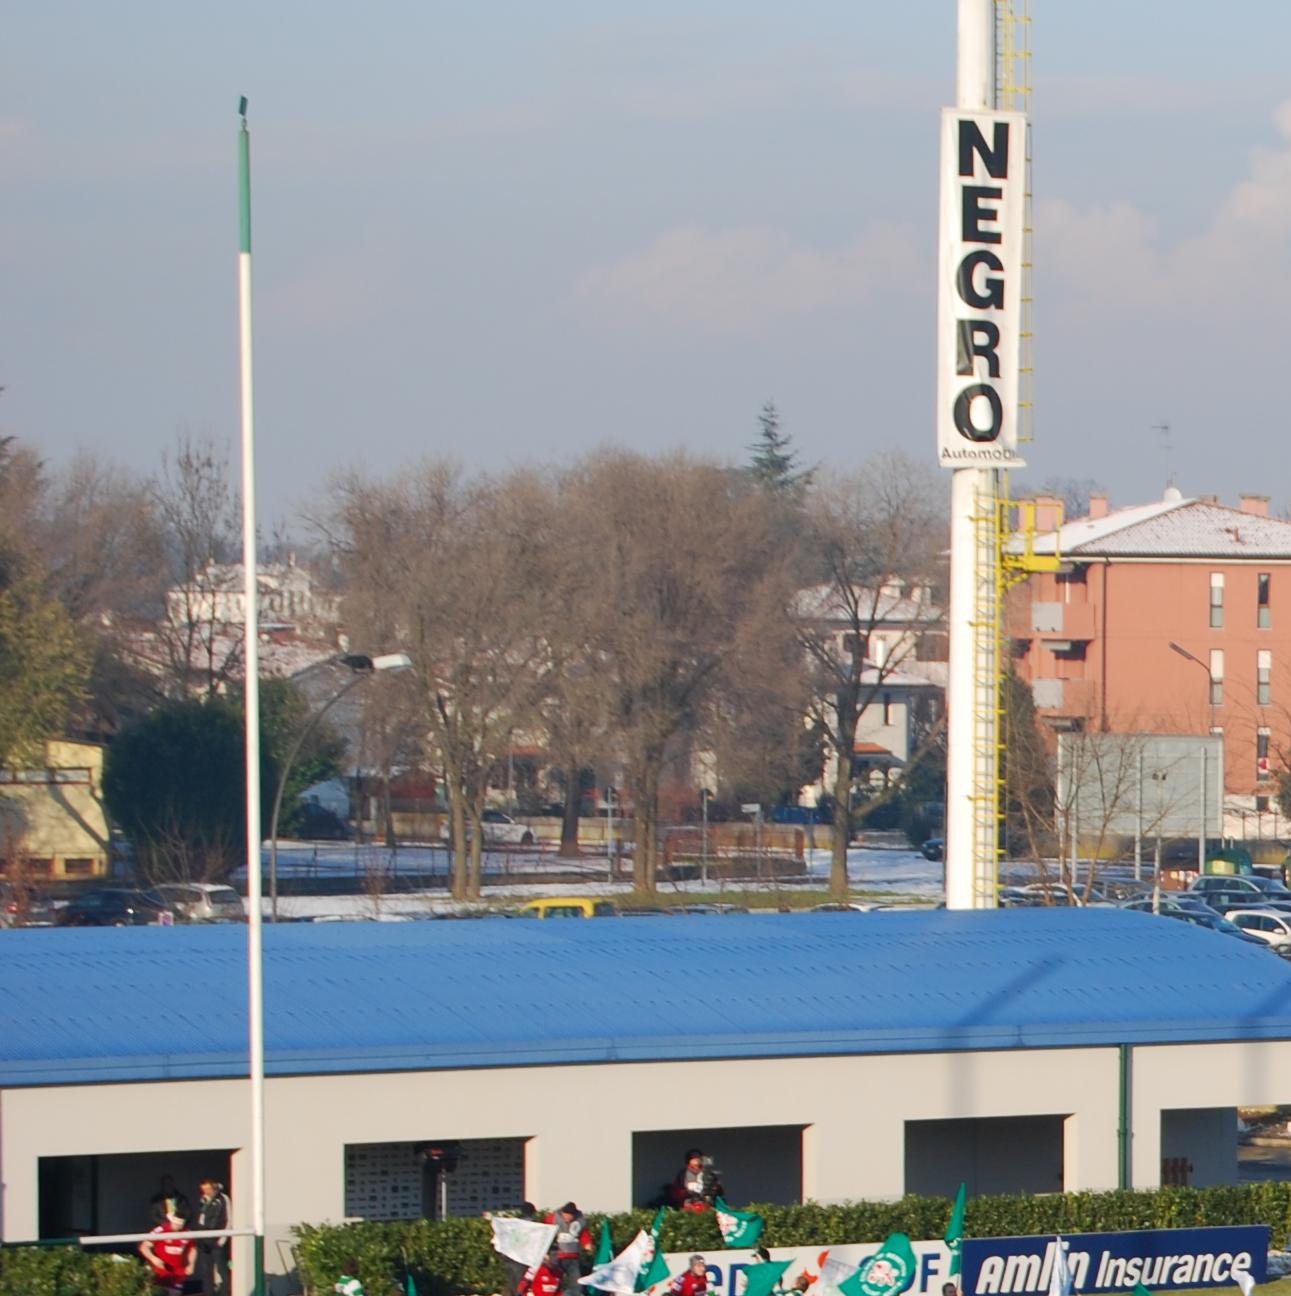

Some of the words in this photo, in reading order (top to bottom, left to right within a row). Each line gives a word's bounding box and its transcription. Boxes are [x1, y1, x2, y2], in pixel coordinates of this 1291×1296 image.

[953, 120, 1010, 443] NEGRO
[975, 1241, 1090, 1294] amln
[1095, 1251, 1252, 1288] Insurance
